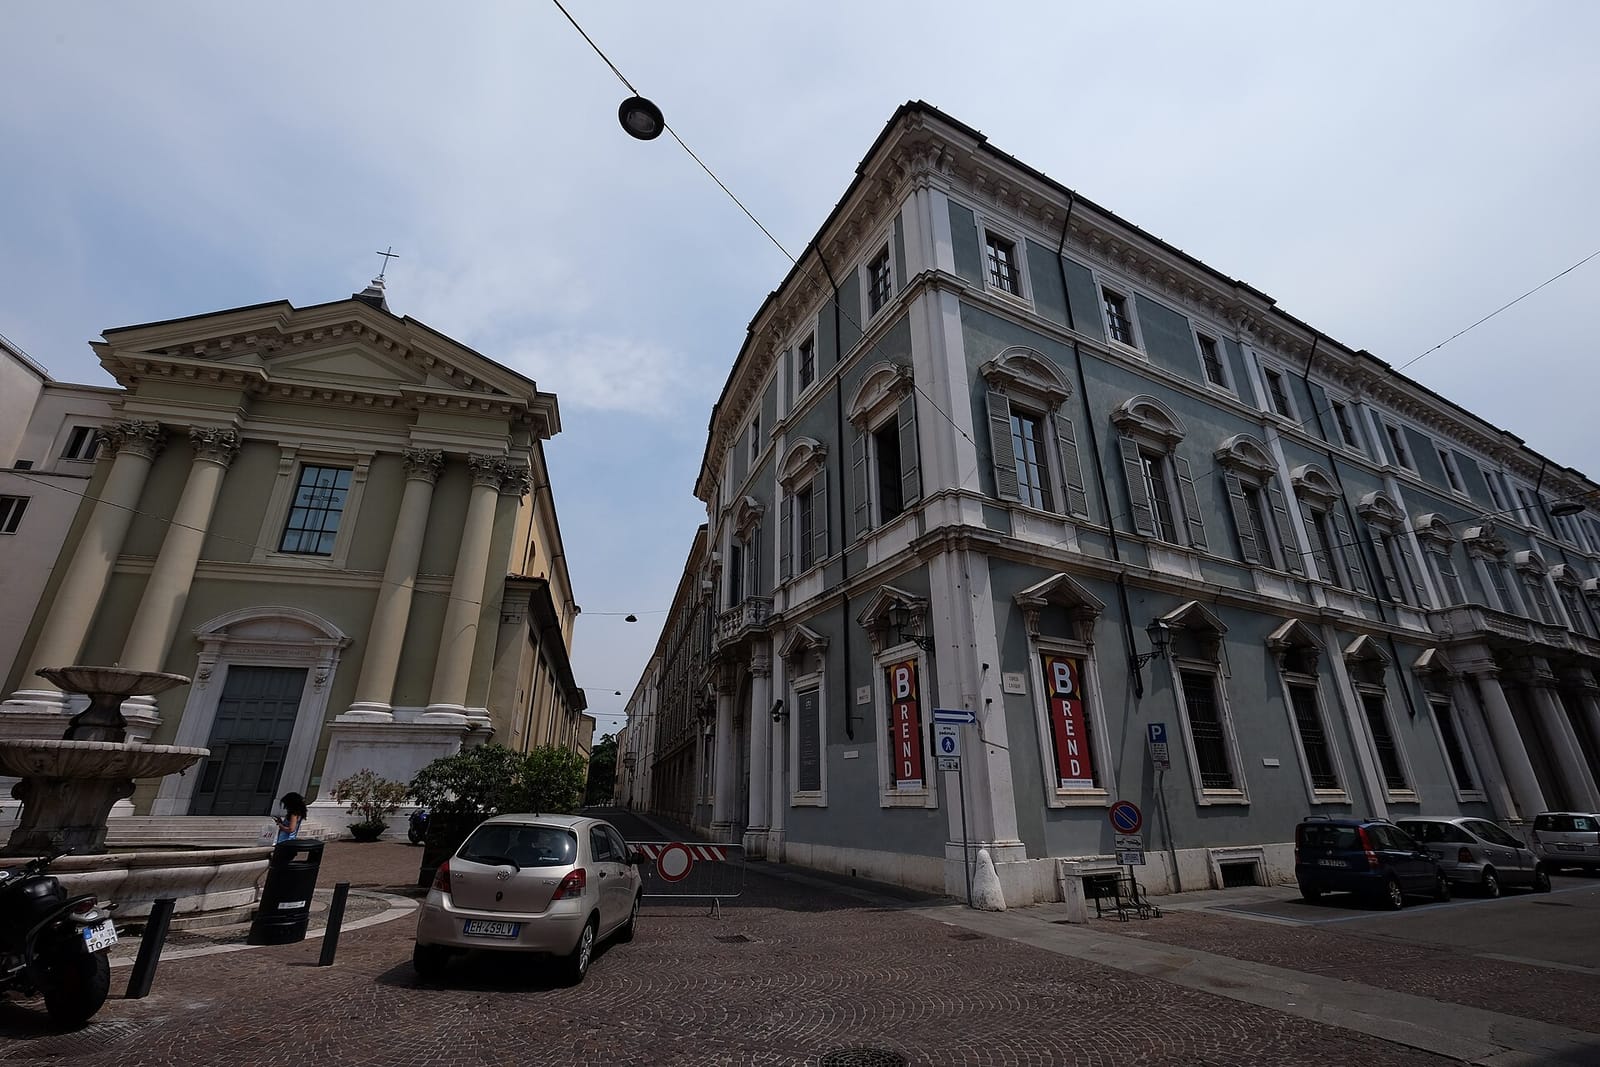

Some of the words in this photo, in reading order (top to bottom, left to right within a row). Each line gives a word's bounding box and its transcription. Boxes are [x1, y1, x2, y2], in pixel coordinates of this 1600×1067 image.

[895, 667, 912, 778] BREND
[1053, 662, 1081, 777] BREND
[1151, 725, 1162, 740] P
